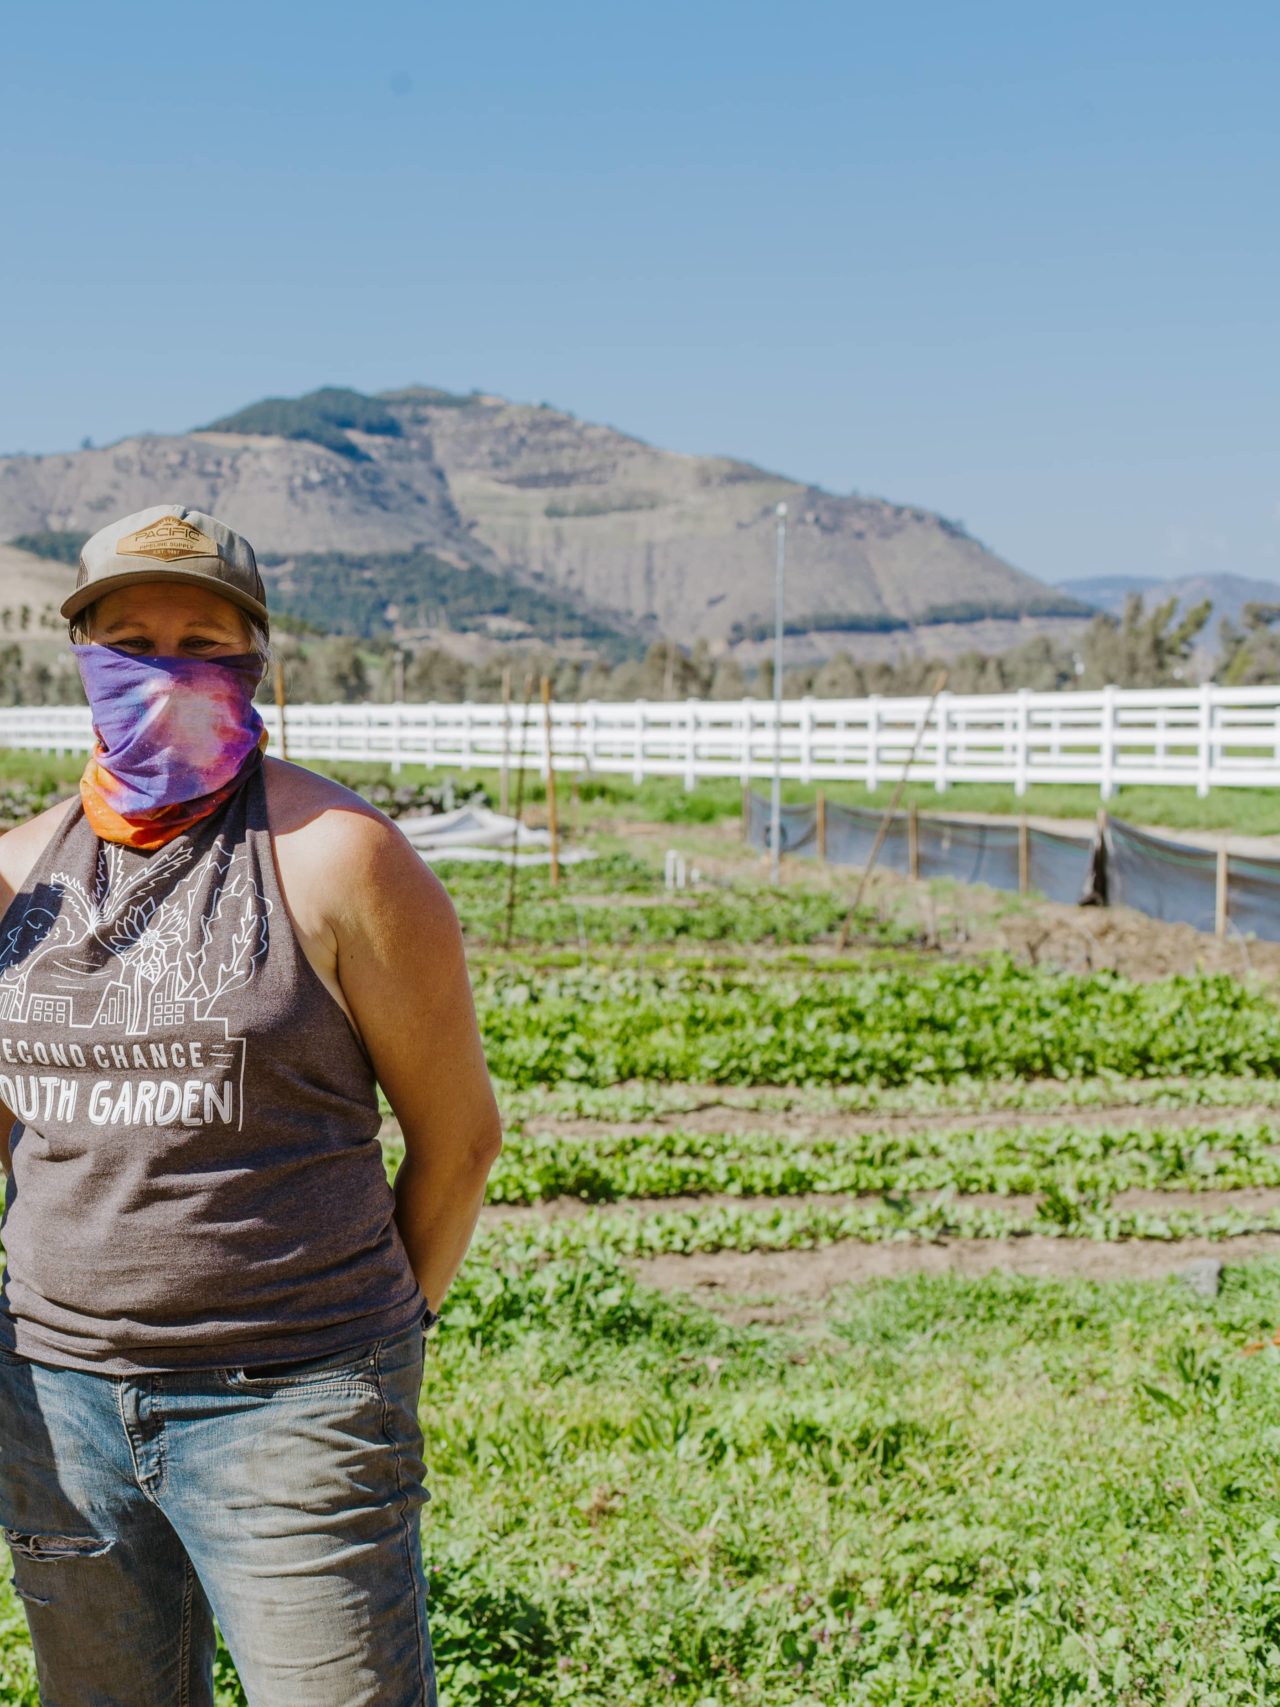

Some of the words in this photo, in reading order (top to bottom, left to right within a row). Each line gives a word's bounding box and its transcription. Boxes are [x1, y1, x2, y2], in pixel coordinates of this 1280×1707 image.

[135, 527, 200, 542] PACIFIC
[169, 542, 194, 550] SUPPLY
[93, 1041, 205, 1069] CHANCE
[88, 1079, 234, 1127] GARDEN
